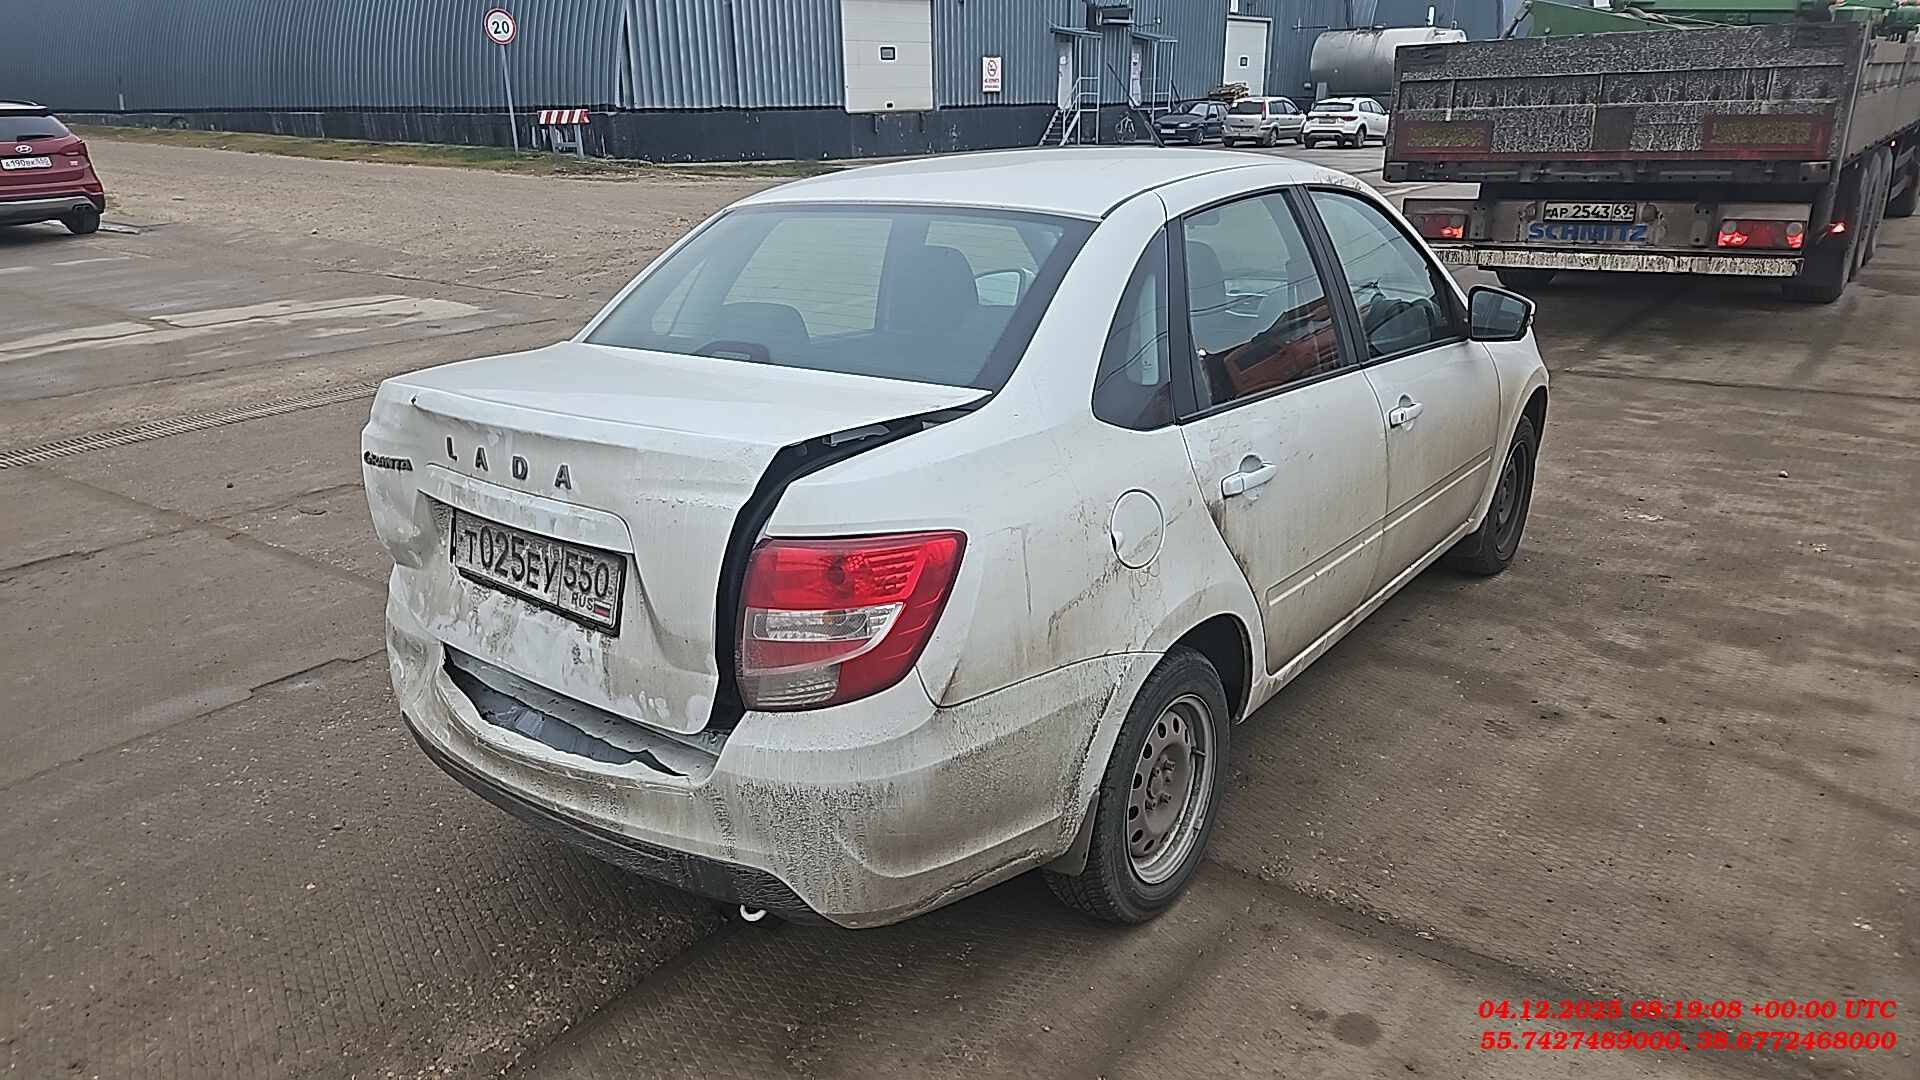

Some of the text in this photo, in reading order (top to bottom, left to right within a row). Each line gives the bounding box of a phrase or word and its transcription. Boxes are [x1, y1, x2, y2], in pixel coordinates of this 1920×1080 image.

[492, 20, 510, 34] 20
[1572, 204, 1611, 219] 2543
[1613, 204, 1630, 216] 69
[1528, 222, 1649, 241] SCHMITZ
[363, 450, 414, 472] GRANTA
[446, 436, 572, 490] LADA
[571, 591, 594, 610] RUS
